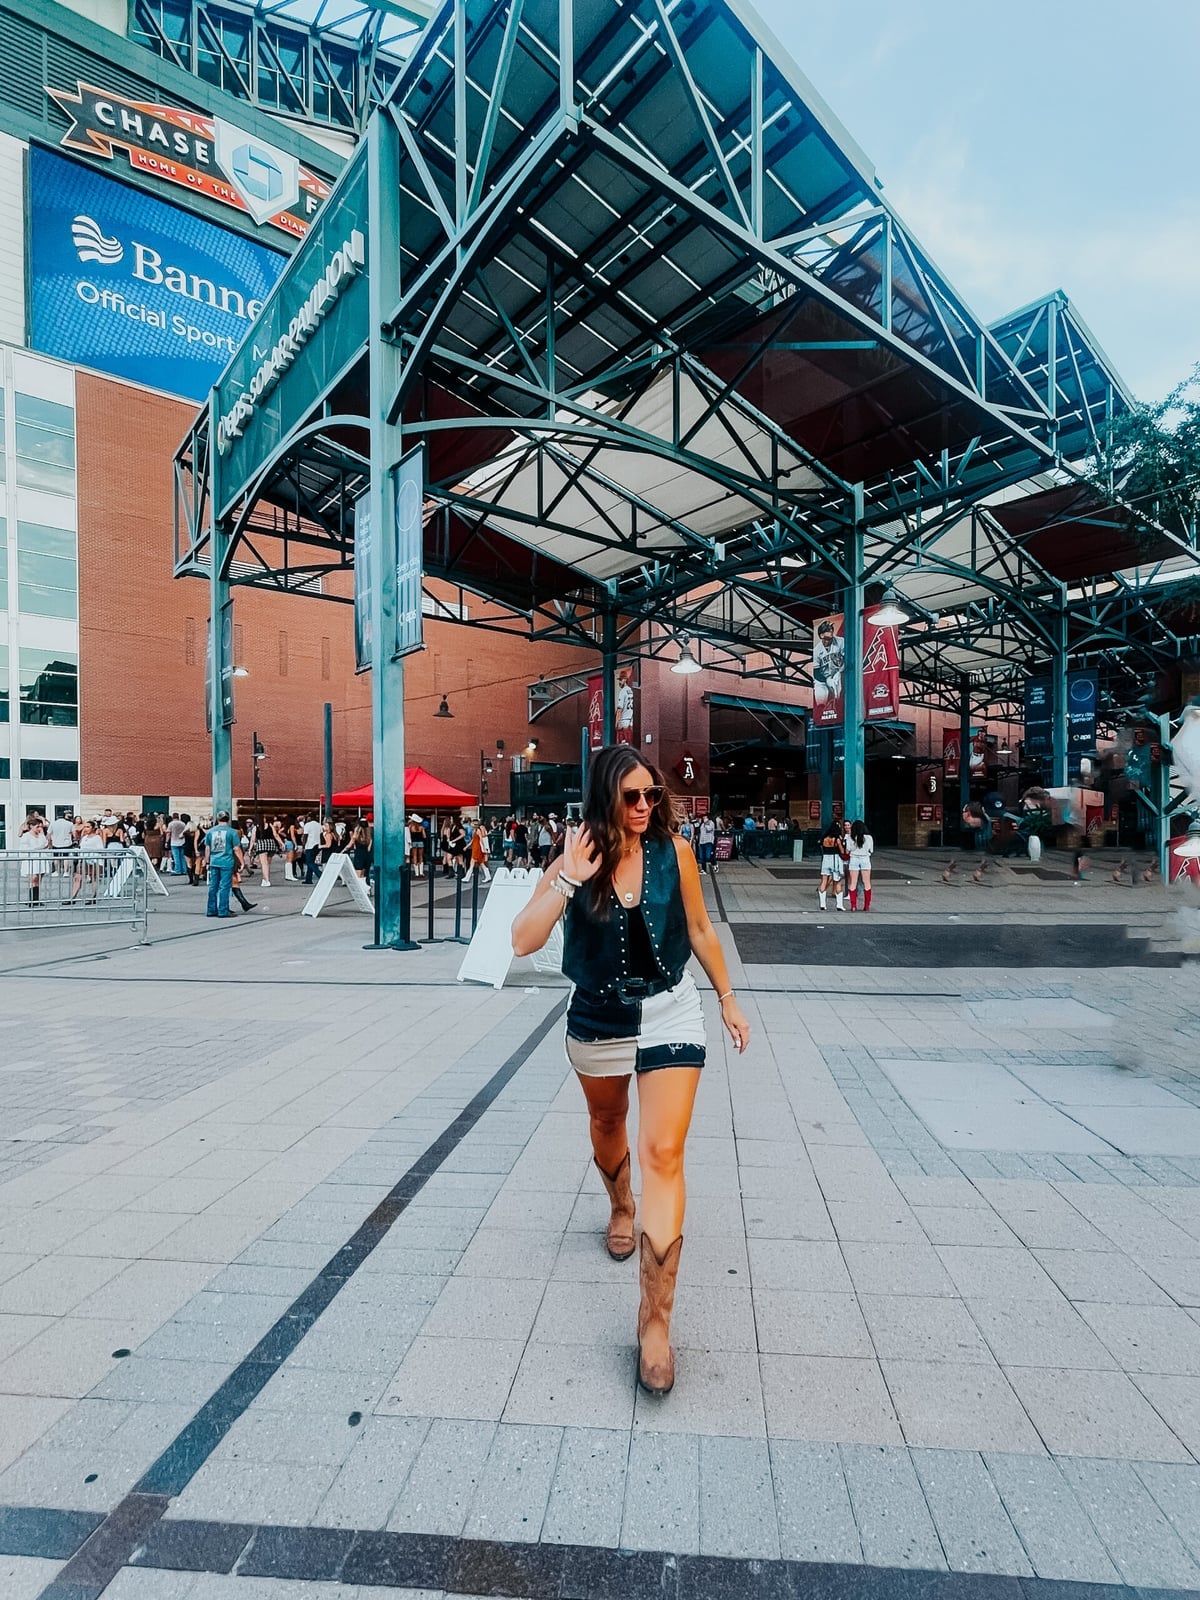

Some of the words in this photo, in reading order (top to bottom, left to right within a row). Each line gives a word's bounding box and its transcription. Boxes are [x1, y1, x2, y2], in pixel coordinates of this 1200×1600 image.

[95, 101, 210, 164] CHASE
[305, 195, 318, 214] F
[138, 154, 177, 175] HOME
[186, 173, 203, 185] OF
[212, 183, 237, 201] THE
[76, 281, 167, 330] Official
